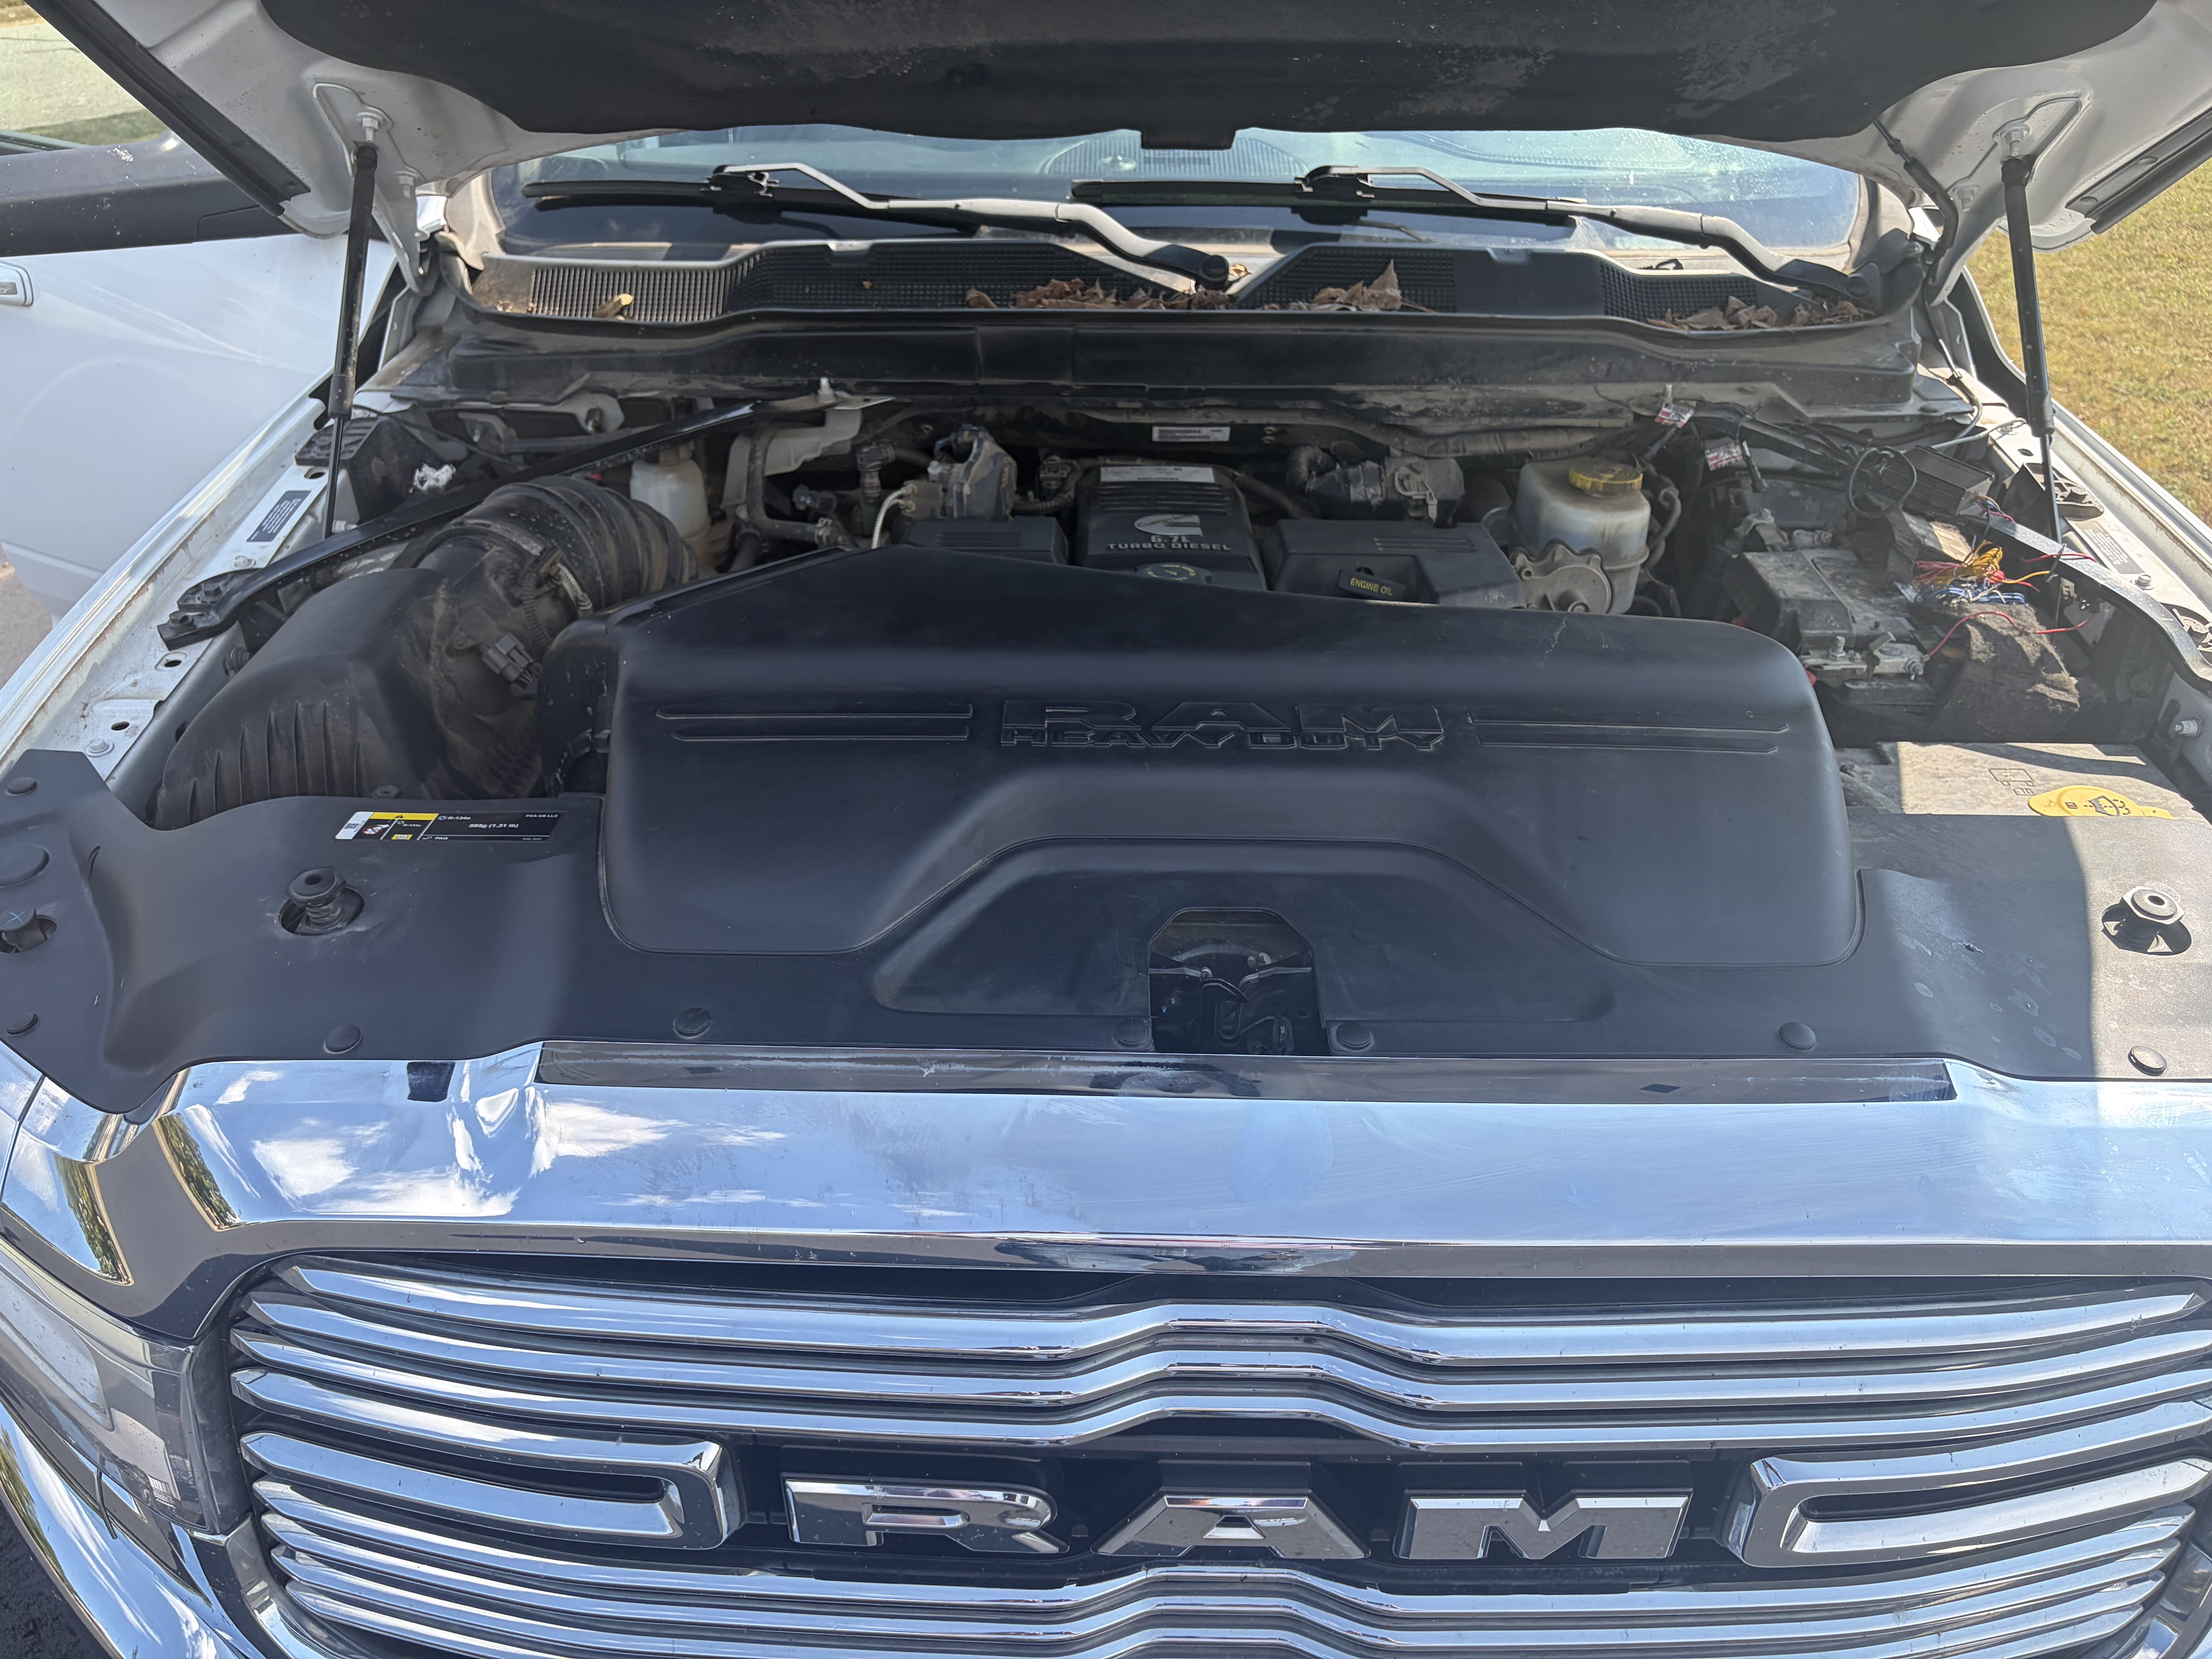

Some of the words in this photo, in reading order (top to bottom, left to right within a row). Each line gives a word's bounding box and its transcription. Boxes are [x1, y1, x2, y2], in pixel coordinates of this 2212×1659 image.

[1350, 578, 1379, 592] ENGINE
[1380, 586, 1393, 596] OIL
[1002, 700, 1443, 734] RAM
[1001, 728, 1235, 748] HEAVY
[1248, 730, 1444, 750] DUTY
[783, 1471, 1694, 1560] RAM
